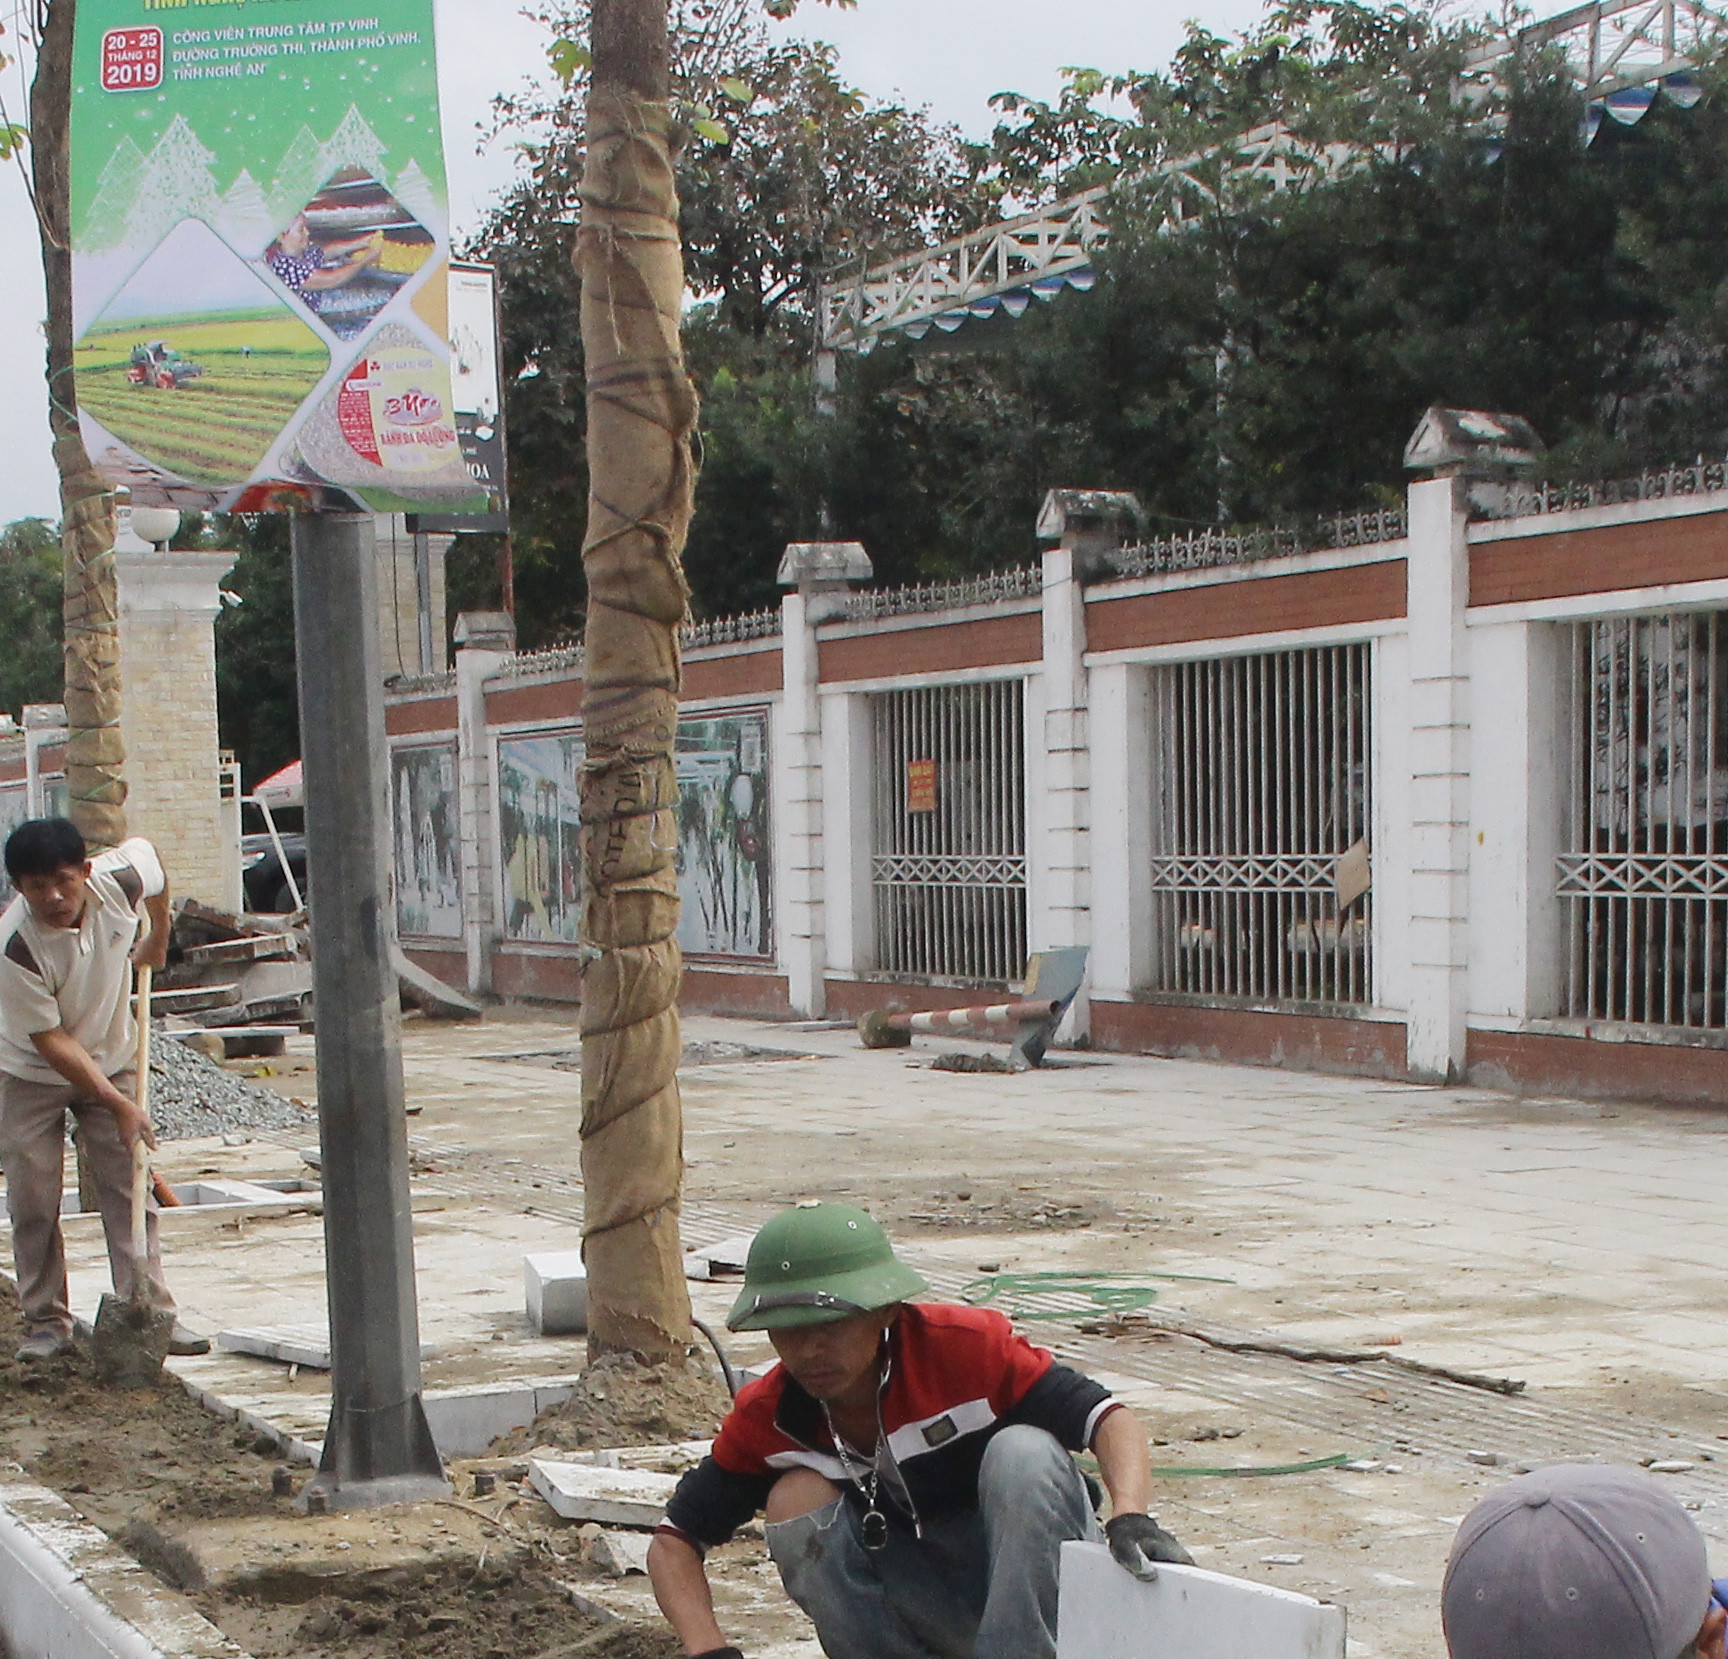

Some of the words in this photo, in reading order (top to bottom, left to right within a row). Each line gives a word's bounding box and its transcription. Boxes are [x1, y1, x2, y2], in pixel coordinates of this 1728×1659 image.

[173, 29, 210, 44] CÔNG
[214, 25, 244, 41] VIÊN
[248, 24, 294, 40] TRUNG
[298, 21, 326, 36] TÂM
[328, 20, 345, 34] TP
[348, 17, 379, 32] VINH
[107, 35, 126, 50] 20
[139, 32, 158, 47] 25
[281, 41, 306, 55] THI,
[310, 36, 354, 53] THÀNH
[357, 31, 385, 49] PHỐ
[108, 50, 143, 62] THÁNG
[146, 49, 157, 60] 12
[107, 62, 158, 85] 2019
[246, 63, 265, 76] AN
